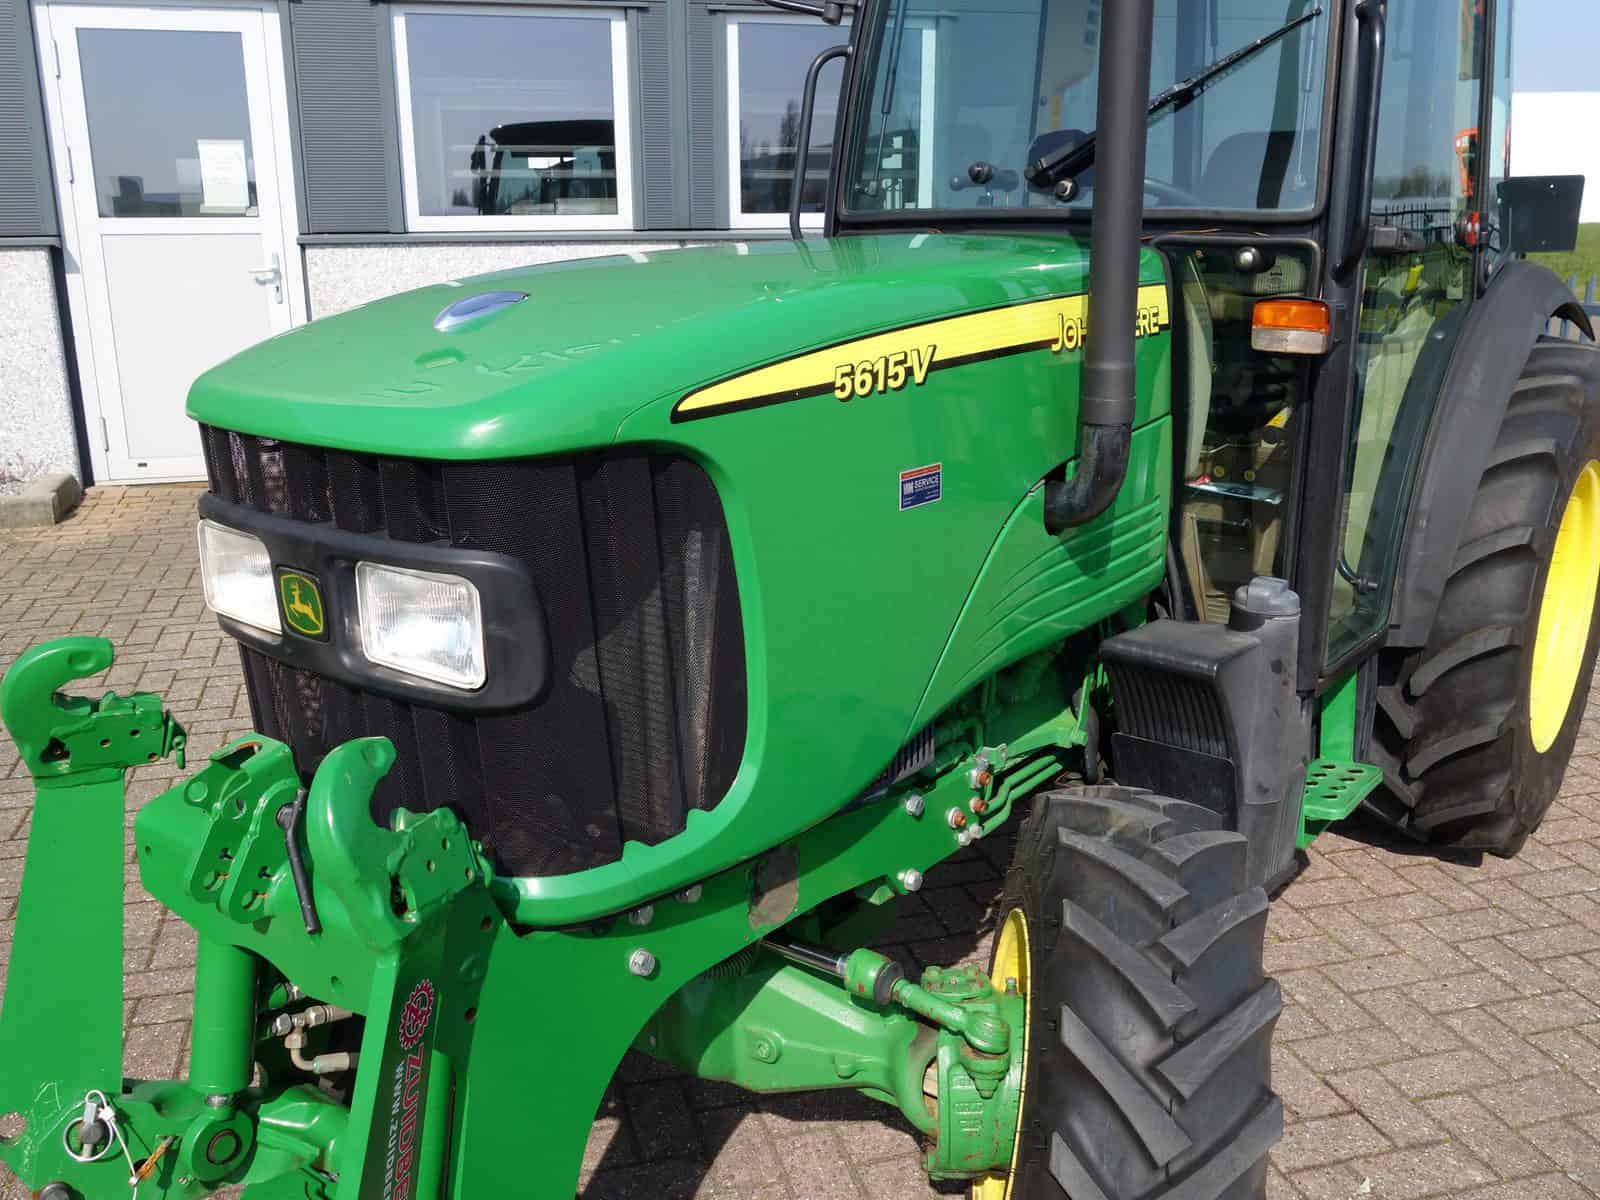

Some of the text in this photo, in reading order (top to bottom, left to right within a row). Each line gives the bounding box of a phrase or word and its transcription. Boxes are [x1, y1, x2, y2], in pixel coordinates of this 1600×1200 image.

[1051, 312, 1088, 352] JOH
[834, 344, 937, 402] 5615V
[914, 474, 939, 489] SERVICE
